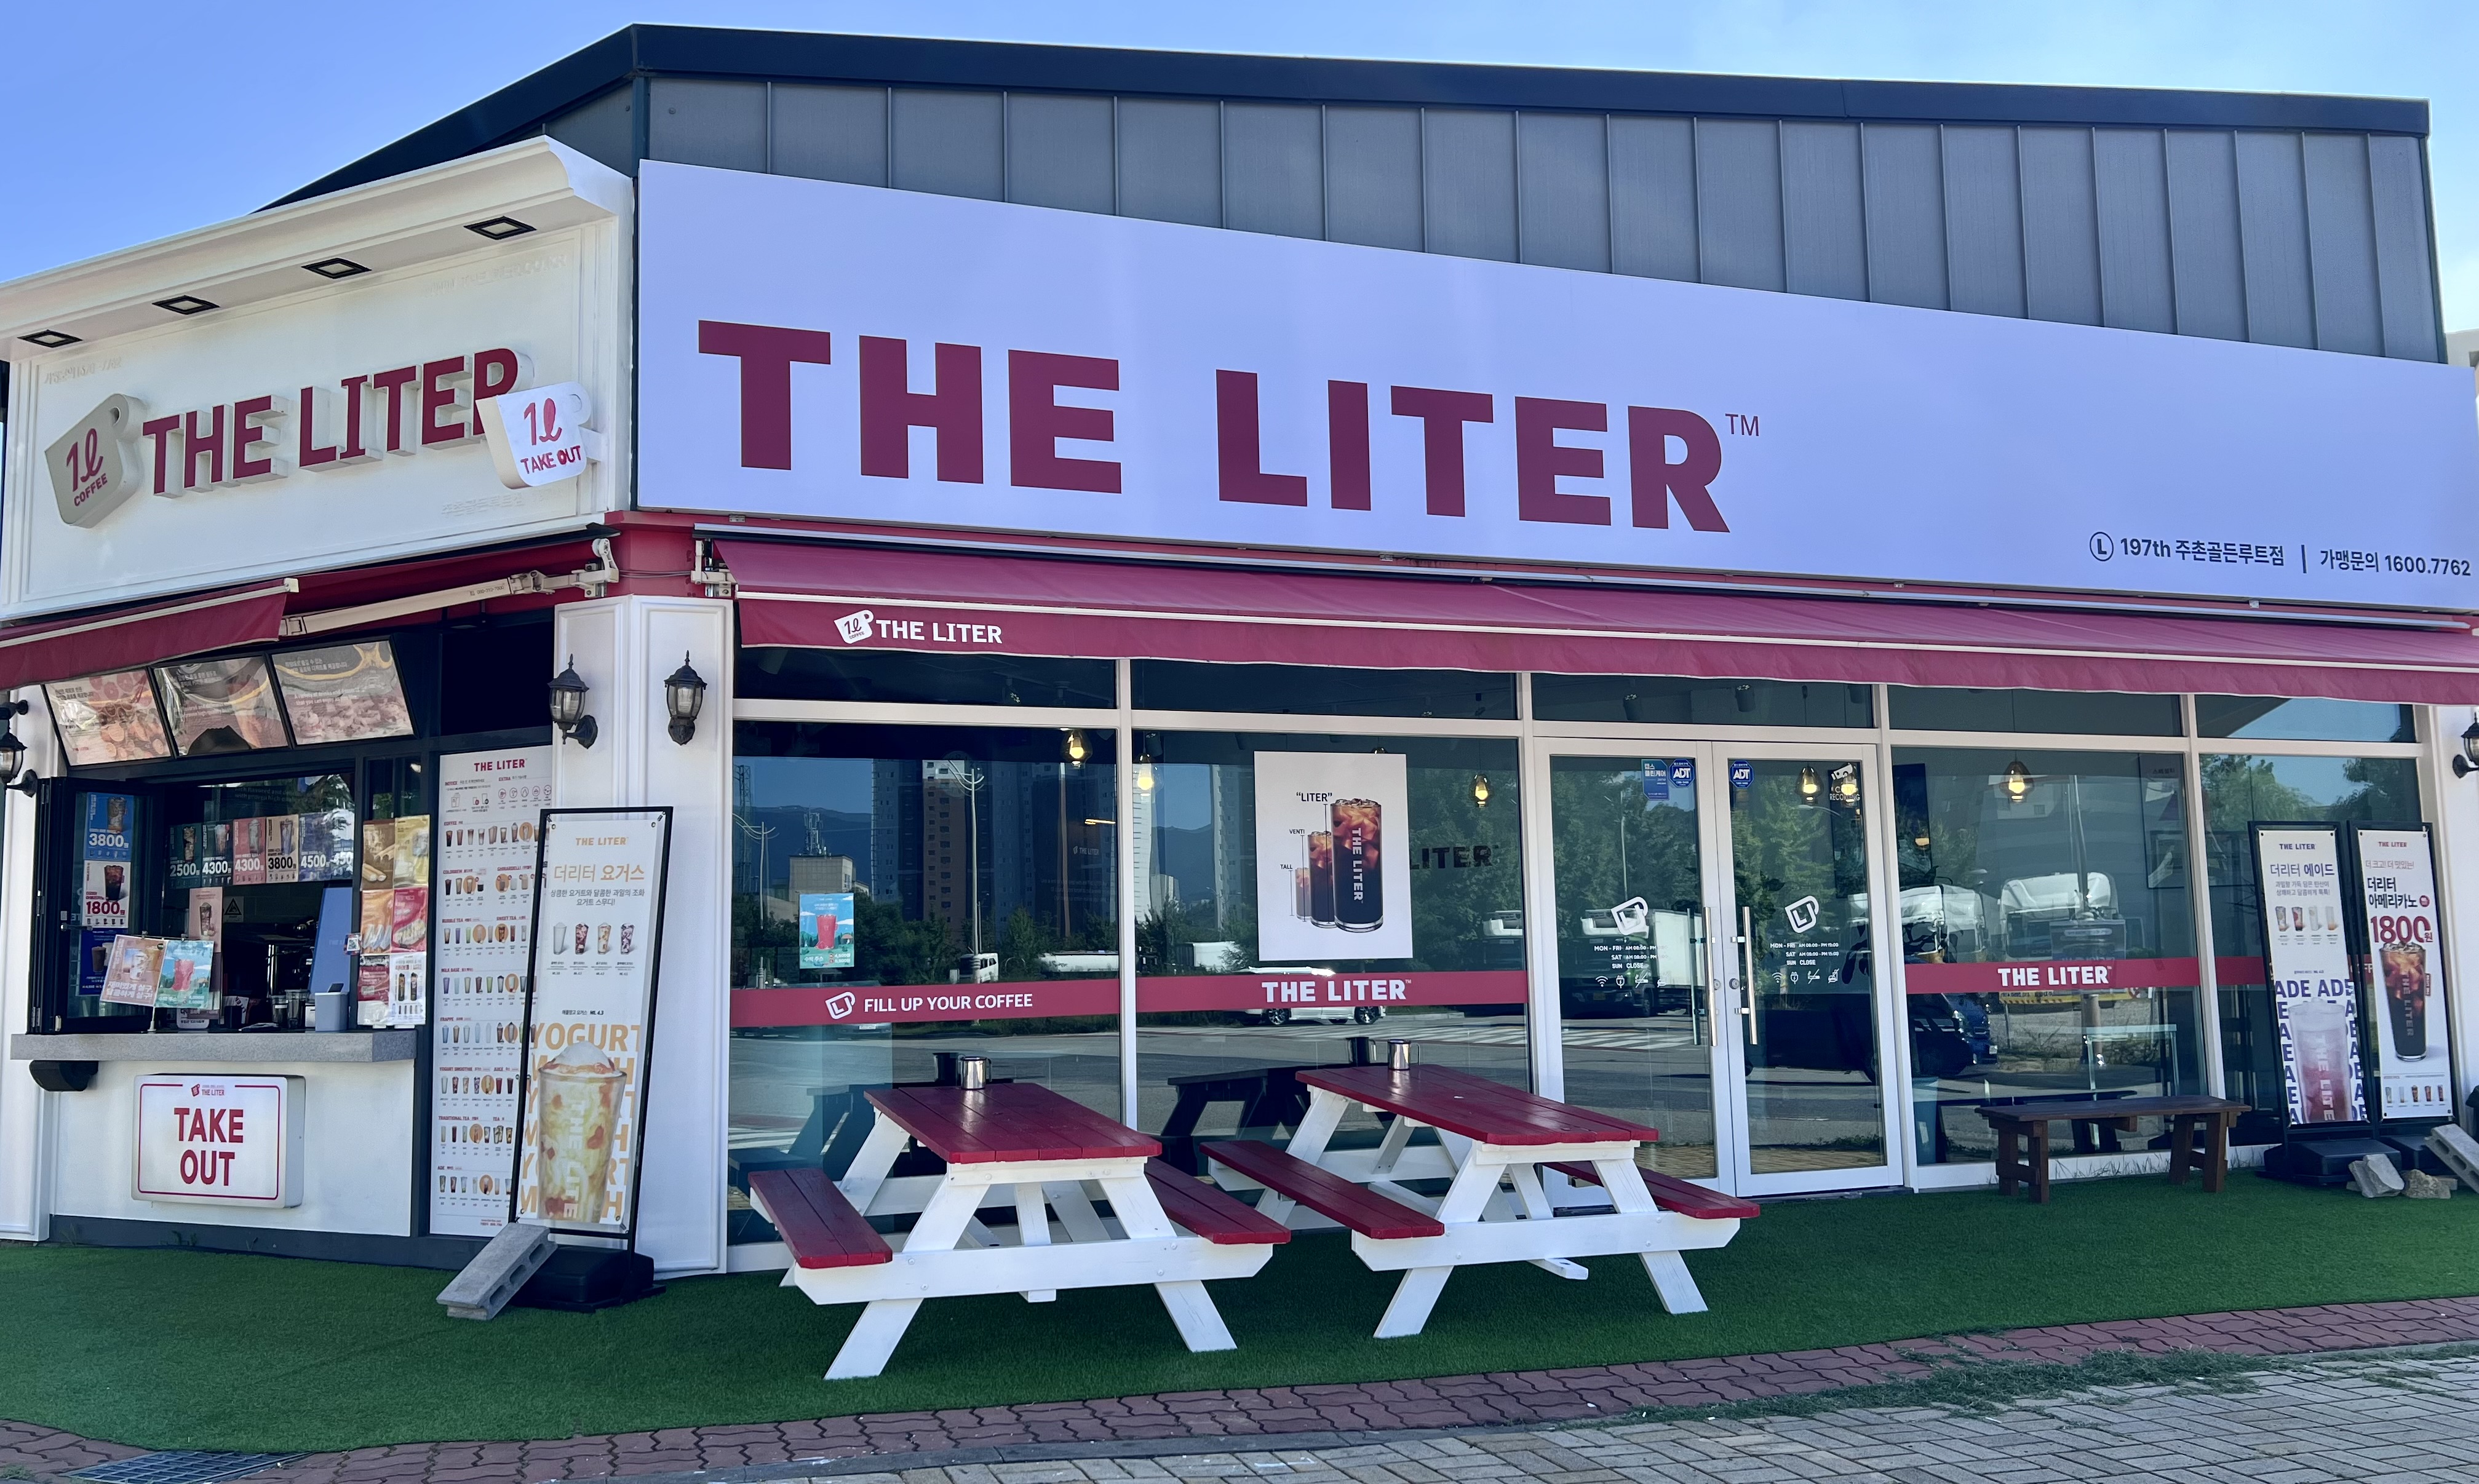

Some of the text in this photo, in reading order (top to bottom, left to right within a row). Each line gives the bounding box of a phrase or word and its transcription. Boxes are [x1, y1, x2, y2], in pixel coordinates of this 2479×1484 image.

[699, 320, 1122, 494] THE
[1216, 369, 1730, 533] LITER
[143, 395, 273, 494] THE
[520, 445, 581, 474] TAKE OUT
[74, 473, 107, 506] COFFEE
[2120, 538, 2471, 576] 197th 주촌골든루트점 가맹문의 1600.7762
[876, 619, 925, 640] THE
[933, 622, 1002, 643] LITER
[474, 758, 525, 772] THE LITER
[1673, 768, 1691, 779] ADT
[1733, 769, 1749, 779] ADT
[598, 837, 626, 846] LITER
[554, 863, 645, 883] 더리터 요거스
[1351, 828, 1364, 902] THE LITER
[2270, 863, 2334, 877] 더리터 에이드
[569, 889, 592, 897] 요거트와
[2367, 876, 2397, 892] 더리터
[2369, 893, 2418, 908] 아메리카노
[1997, 967, 2040, 986] THE
[2047, 966, 2109, 985] LITER
[1261, 981, 1316, 1003] THE
[1328, 979, 1407, 1002] LITER
[2276, 980, 2311, 998] ADE
[864, 998, 897, 1012] FILL
[901, 997, 923, 1012] UP
[927, 996, 971, 1010] YOUR
[975, 993, 1033, 1009] COFFEE
[173, 1107, 244, 1143] TAKE
[180, 1149, 236, 1186] OUT
